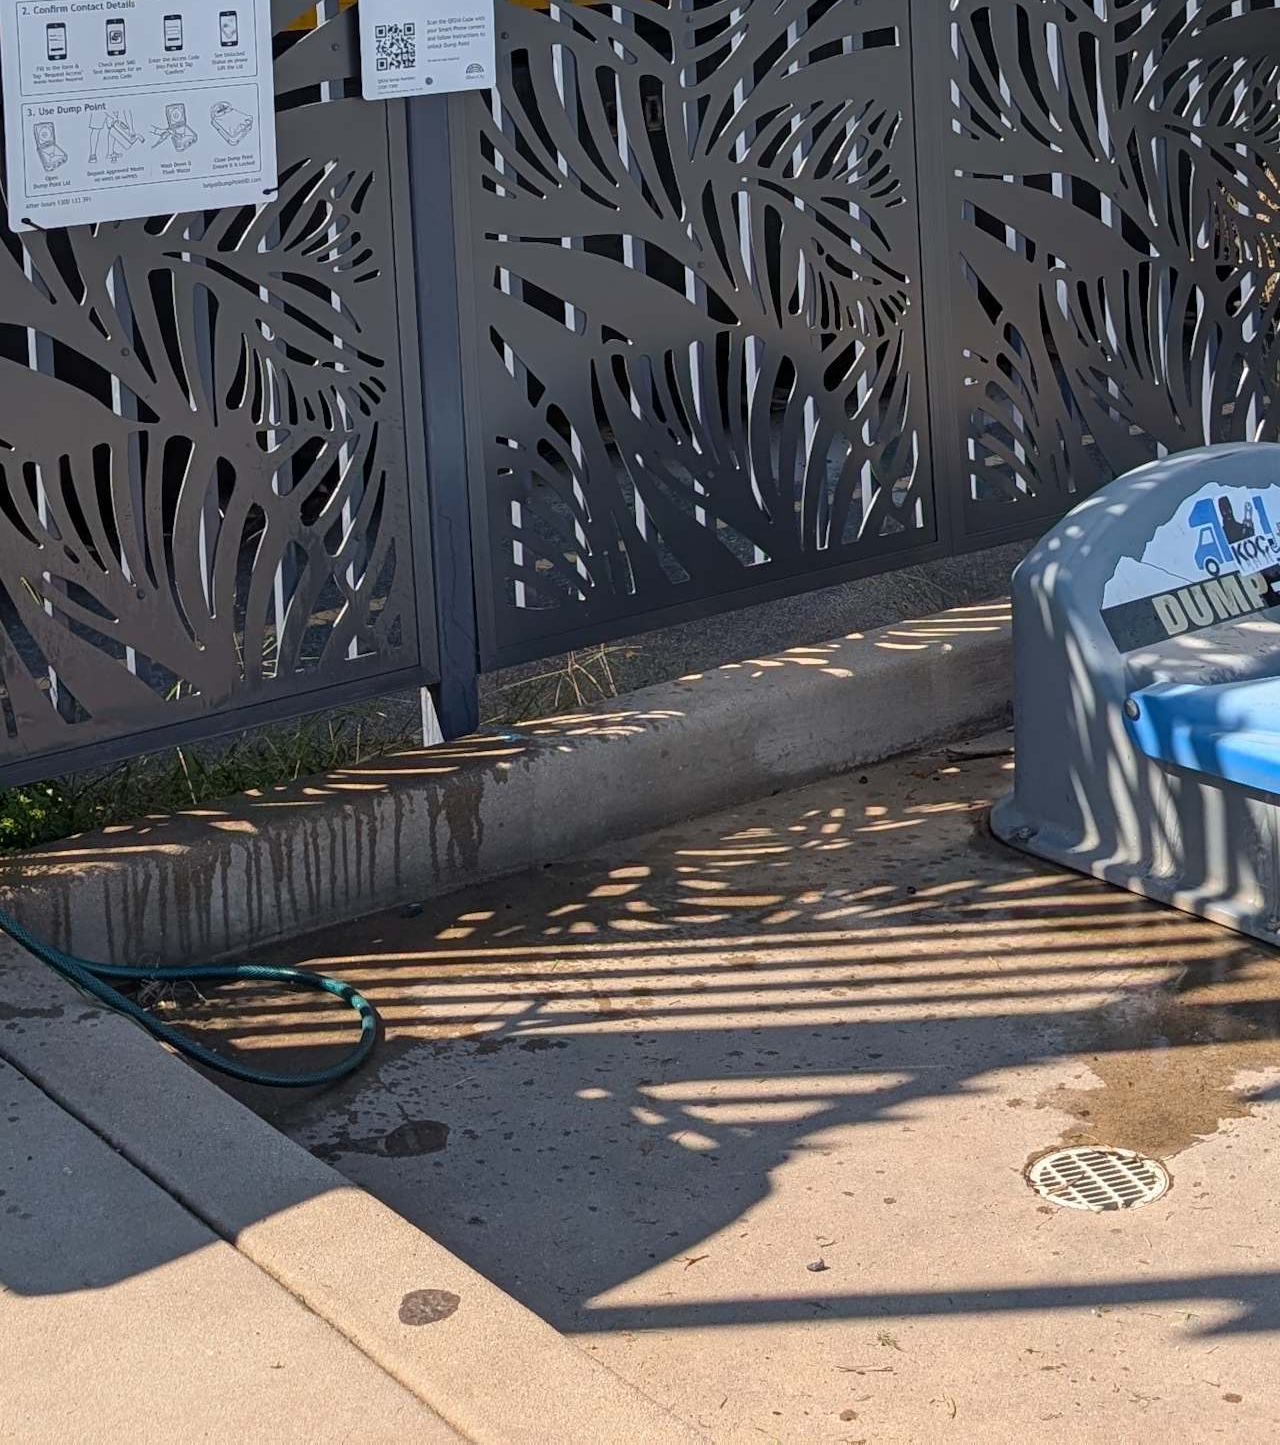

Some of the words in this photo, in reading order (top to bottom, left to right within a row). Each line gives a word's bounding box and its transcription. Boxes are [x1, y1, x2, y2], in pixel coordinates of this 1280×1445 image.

[21, 7, 30, 15] 2.
[33, 5, 68, 14] Confirm
[71, 3, 104, 12] Contact
[106, 0, 136, 9] Details
[27, 108, 36, 116] 3.
[38, 107, 54, 115] Use
[57, 105, 82, 114] Dump
[84, 103, 106, 111] Point
